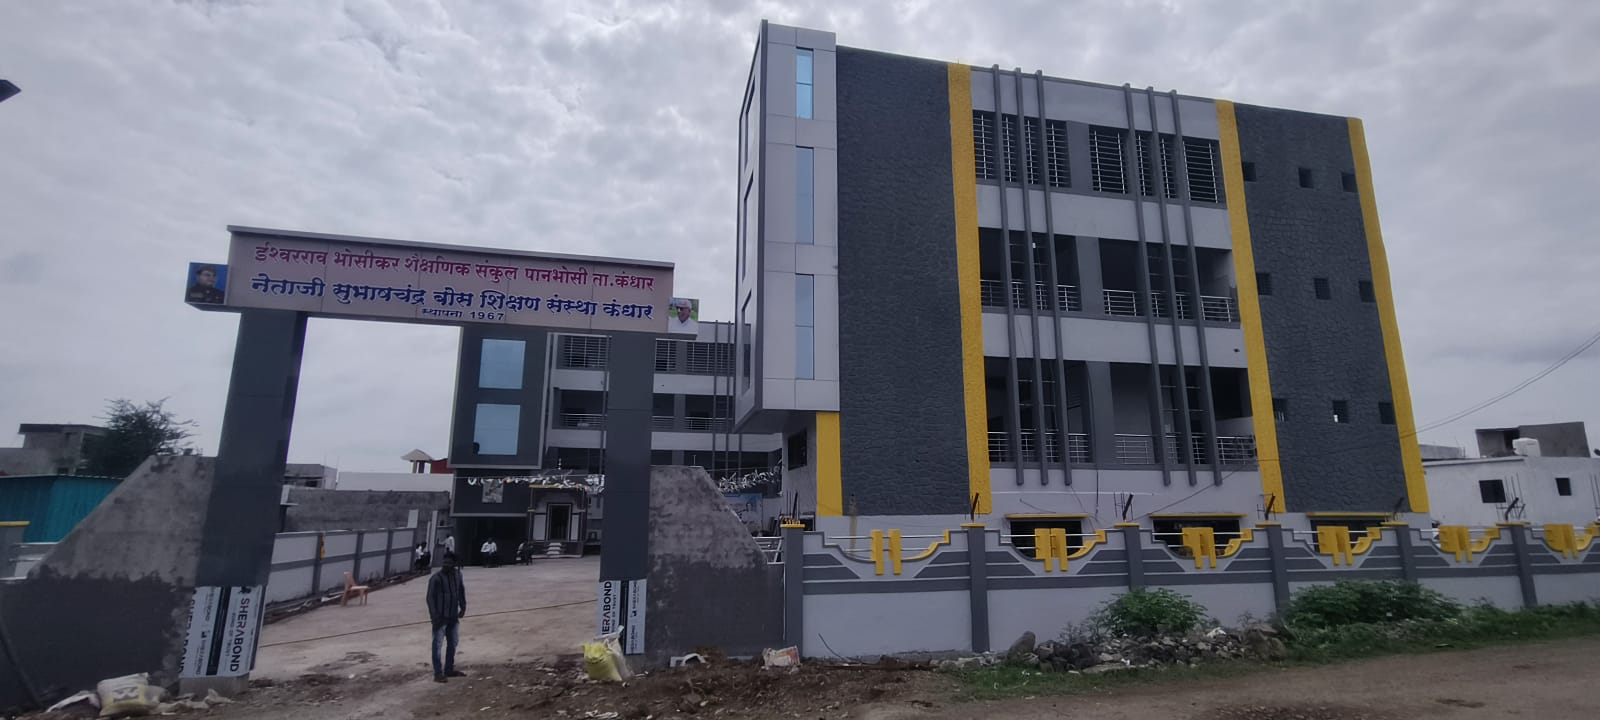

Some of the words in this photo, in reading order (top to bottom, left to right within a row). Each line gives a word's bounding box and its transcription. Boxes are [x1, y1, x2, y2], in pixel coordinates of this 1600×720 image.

[255, 242, 328, 265] ईश्वरराव
[334, 249, 400, 270] भोसीकर
[404, 254, 471, 276] शैक्षणिक
[475, 260, 519, 283] संकुल
[525, 266, 588, 285] पानभोसी
[252, 273, 326, 297] नेताजी
[333, 284, 426, 304] सुभाषचंद्र
[433, 286, 474, 307] बोस
[480, 289, 541, 312] शिक्षण
[547, 294, 597, 315] संस्था
[603, 299, 653, 319] कंधार
[470, 311, 504, 320] 1967
[602, 581, 612, 635] ERABOND
[230, 598, 250, 672] SHERABOND
